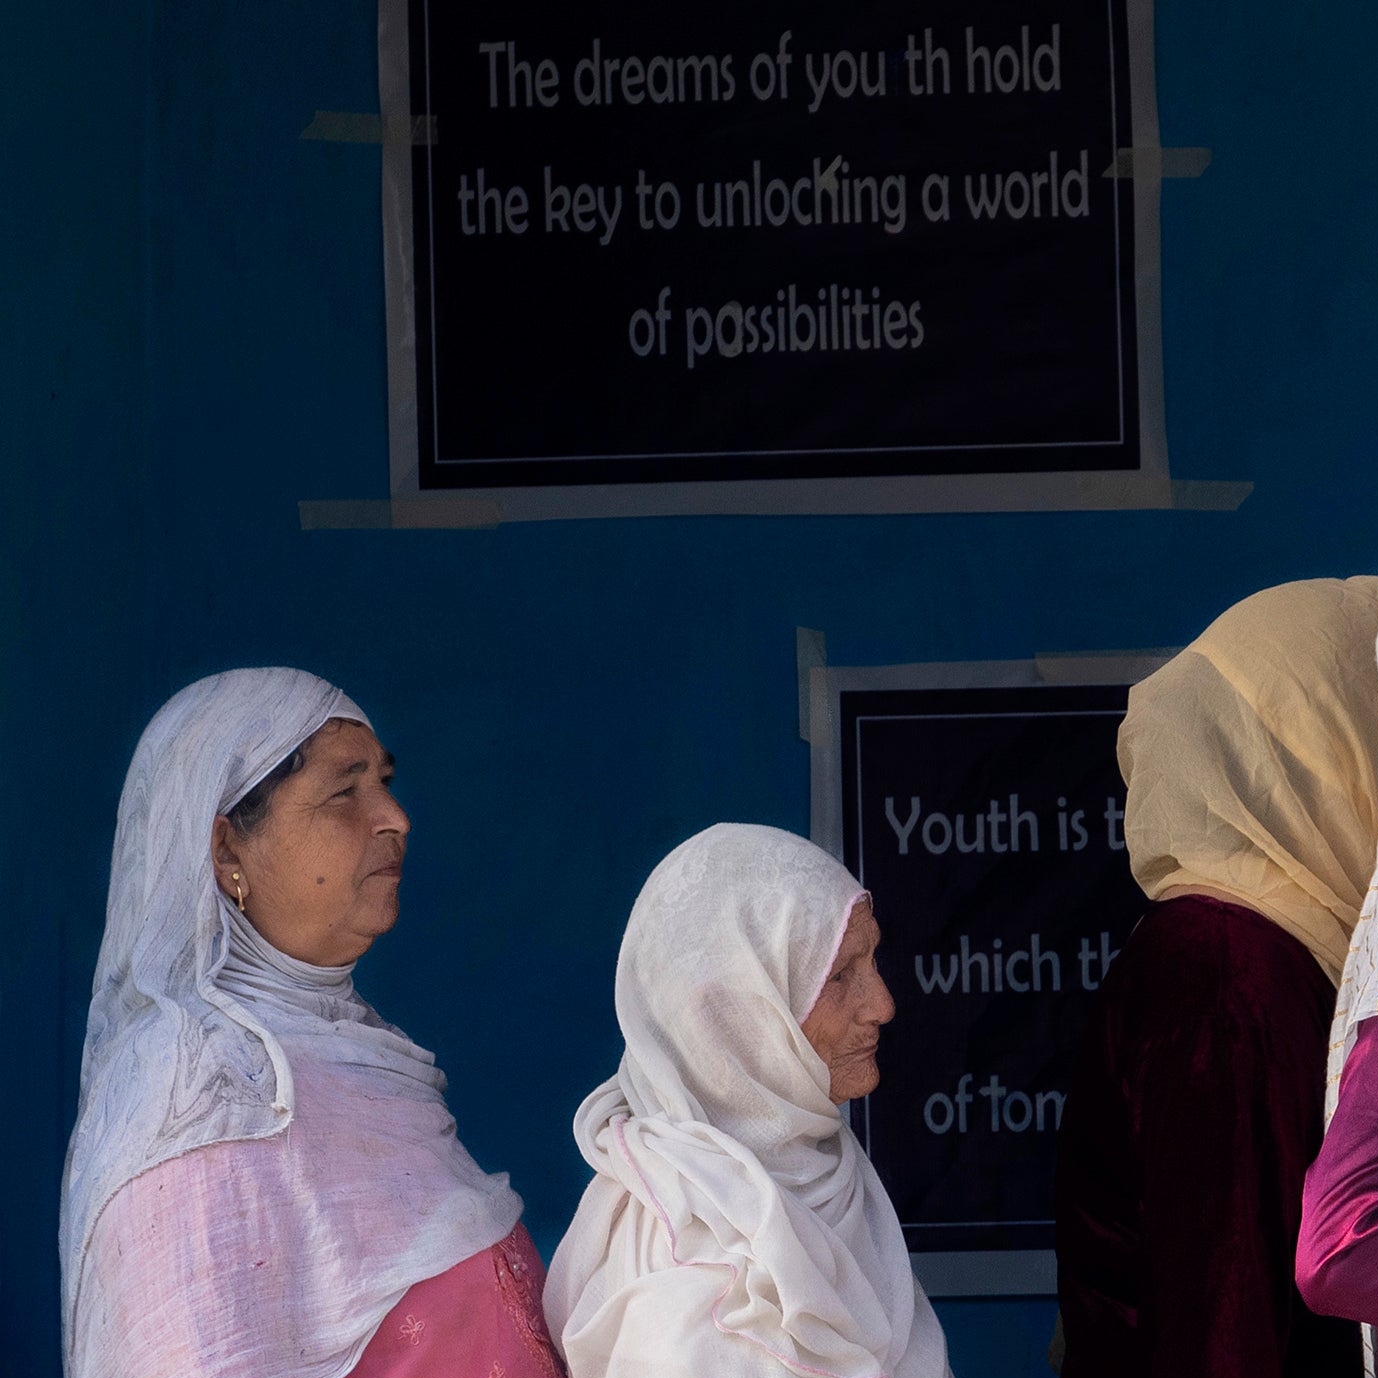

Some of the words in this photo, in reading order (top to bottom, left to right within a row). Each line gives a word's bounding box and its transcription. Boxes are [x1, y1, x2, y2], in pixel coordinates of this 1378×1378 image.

[479, 41, 559, 107] The
[574, 39, 735, 105] dreams
[750, 31, 792, 100] of
[966, 24, 1060, 93] hold
[458, 168, 528, 235] the
[544, 166, 622, 245] key
[636, 170, 680, 229] to
[697, 155, 906, 234] unlocking
[922, 174, 949, 222] a
[965, 150, 1089, 219] world
[629, 287, 671, 356] of
[885, 794, 1038, 854] Youth
[1058, 797, 1088, 850] is
[915, 934, 1060, 994] which
[924, 1074, 972, 1134] of
